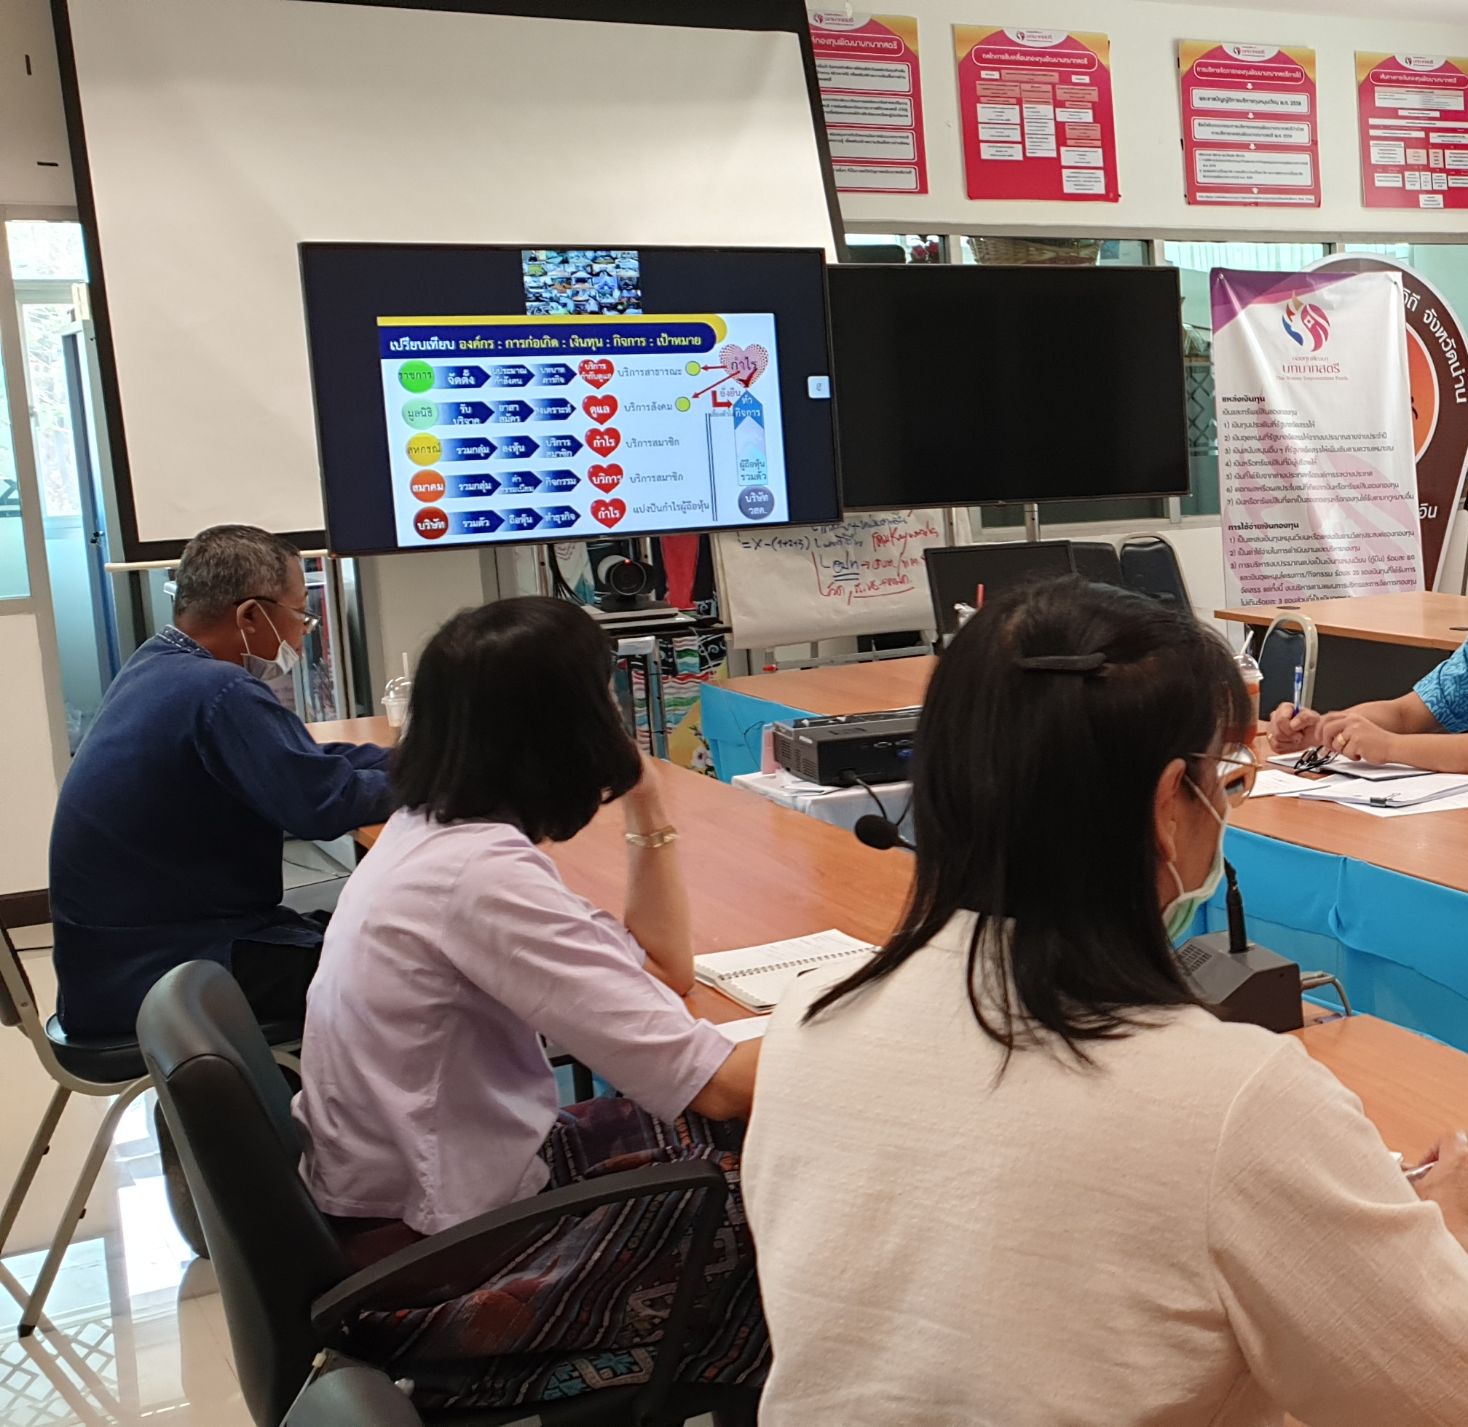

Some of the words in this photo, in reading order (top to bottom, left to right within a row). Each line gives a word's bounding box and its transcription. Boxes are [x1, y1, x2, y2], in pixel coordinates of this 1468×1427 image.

[390, 336, 456, 350] เปรียบเทียบ
[459, 335, 495, 349] องค์กร
[505, 335, 559, 348] การก่อเกิด
[570, 335, 603, 350] เงินทุน
[613, 334, 646, 346] กิจการ
[656, 333, 701, 346] เป้าหมาย
[1423, 308, 1467, 404] จังหวัดน่าน
[731, 356, 757, 371] กำไร
[1282, 362, 1341, 373] บทบาทสตรี
[448, 369, 475, 385] จัดตั้ง
[618, 365, 682, 377] บริการสาธารณะ
[624, 401, 673, 413] บริการสังคม
[593, 435, 615, 448] กำไร
[626, 436, 680, 449] บริการสมาชิก
[630, 471, 684, 484] บริการสมาชิก
[412, 483, 444, 493] สมาคม
[598, 506, 620, 519] กำไร
[1228, 522, 1299, 531] การใช้จ่ายเงินกองทุน
